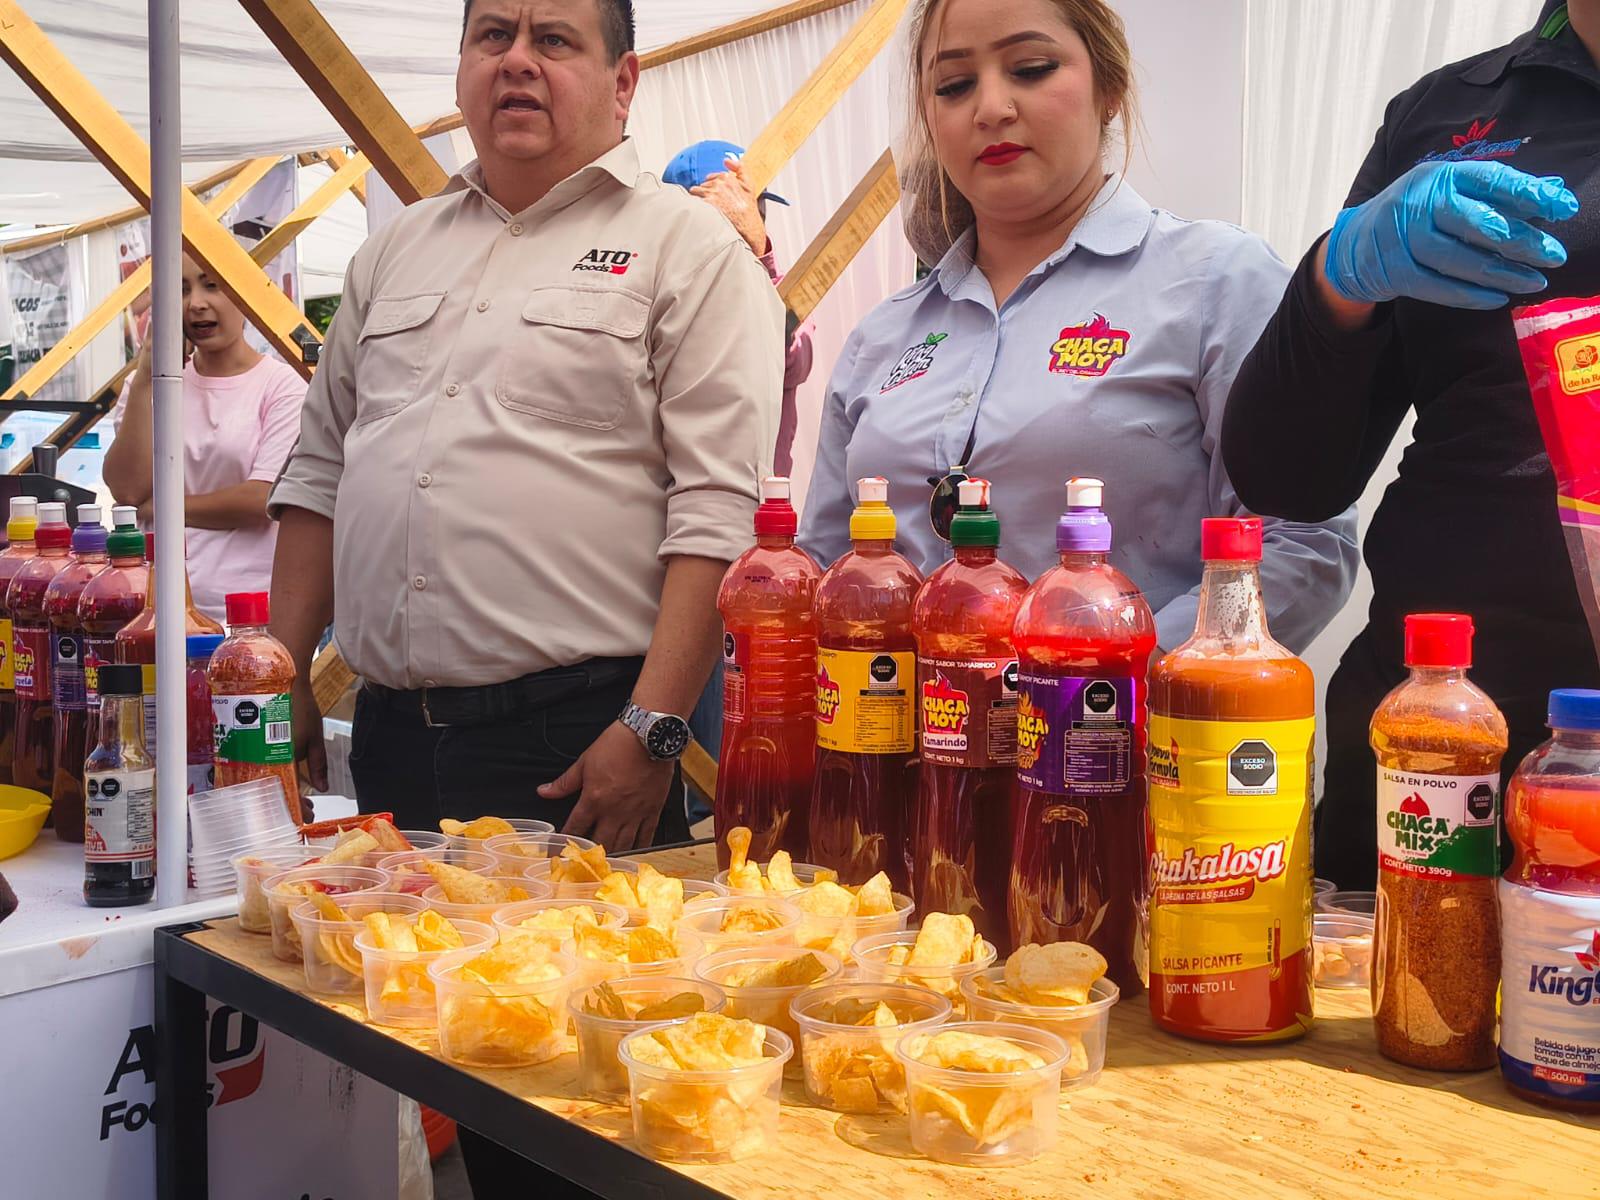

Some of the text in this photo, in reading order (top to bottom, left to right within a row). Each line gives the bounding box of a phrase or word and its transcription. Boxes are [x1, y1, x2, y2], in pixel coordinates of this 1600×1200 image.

[579, 248, 631, 265] ATO
[572, 263, 610, 272] Foods
[1052, 337, 1124, 355] CHAGA
[1056, 352, 1112, 369] MOY
[1567, 380, 1580, 388] de
[1581, 377, 1591, 385] la
[957, 661, 998, 669] TAMARINDO
[1033, 676, 1060, 687] PICANTE
[925, 696, 967, 716] CHAGA
[928, 711, 960, 730] MOY
[924, 736, 967, 748] Tamarindo
[956, 757, 964, 765] kg
[1383, 772, 1458, 789] SALSA EN POLVO
[1386, 810, 1449, 836] CHAGA
[1395, 830, 1434, 852] MIX
[1427, 866, 1452, 878] 390g
[1196, 889, 1211, 901] LAS
[1212, 887, 1245, 899] SALSAS
[1162, 953, 1243, 970] SALSA PICANTE
[1166, 980, 1236, 994] CONT. NETO 1 L
[1528, 964, 1600, 1007] King
[104, 1005, 259, 1096] AO
[1534, 1037, 1597, 1055] Bebida de jugo
[1534, 1045, 1563, 1058] tomate
[1565, 1052, 1581, 1060] con
[1534, 1053, 1558, 1065] toque
[1558, 1058, 1571, 1067] de
[1551, 1071, 1569, 1082] 500
[1569, 1075, 1583, 1084] ml
